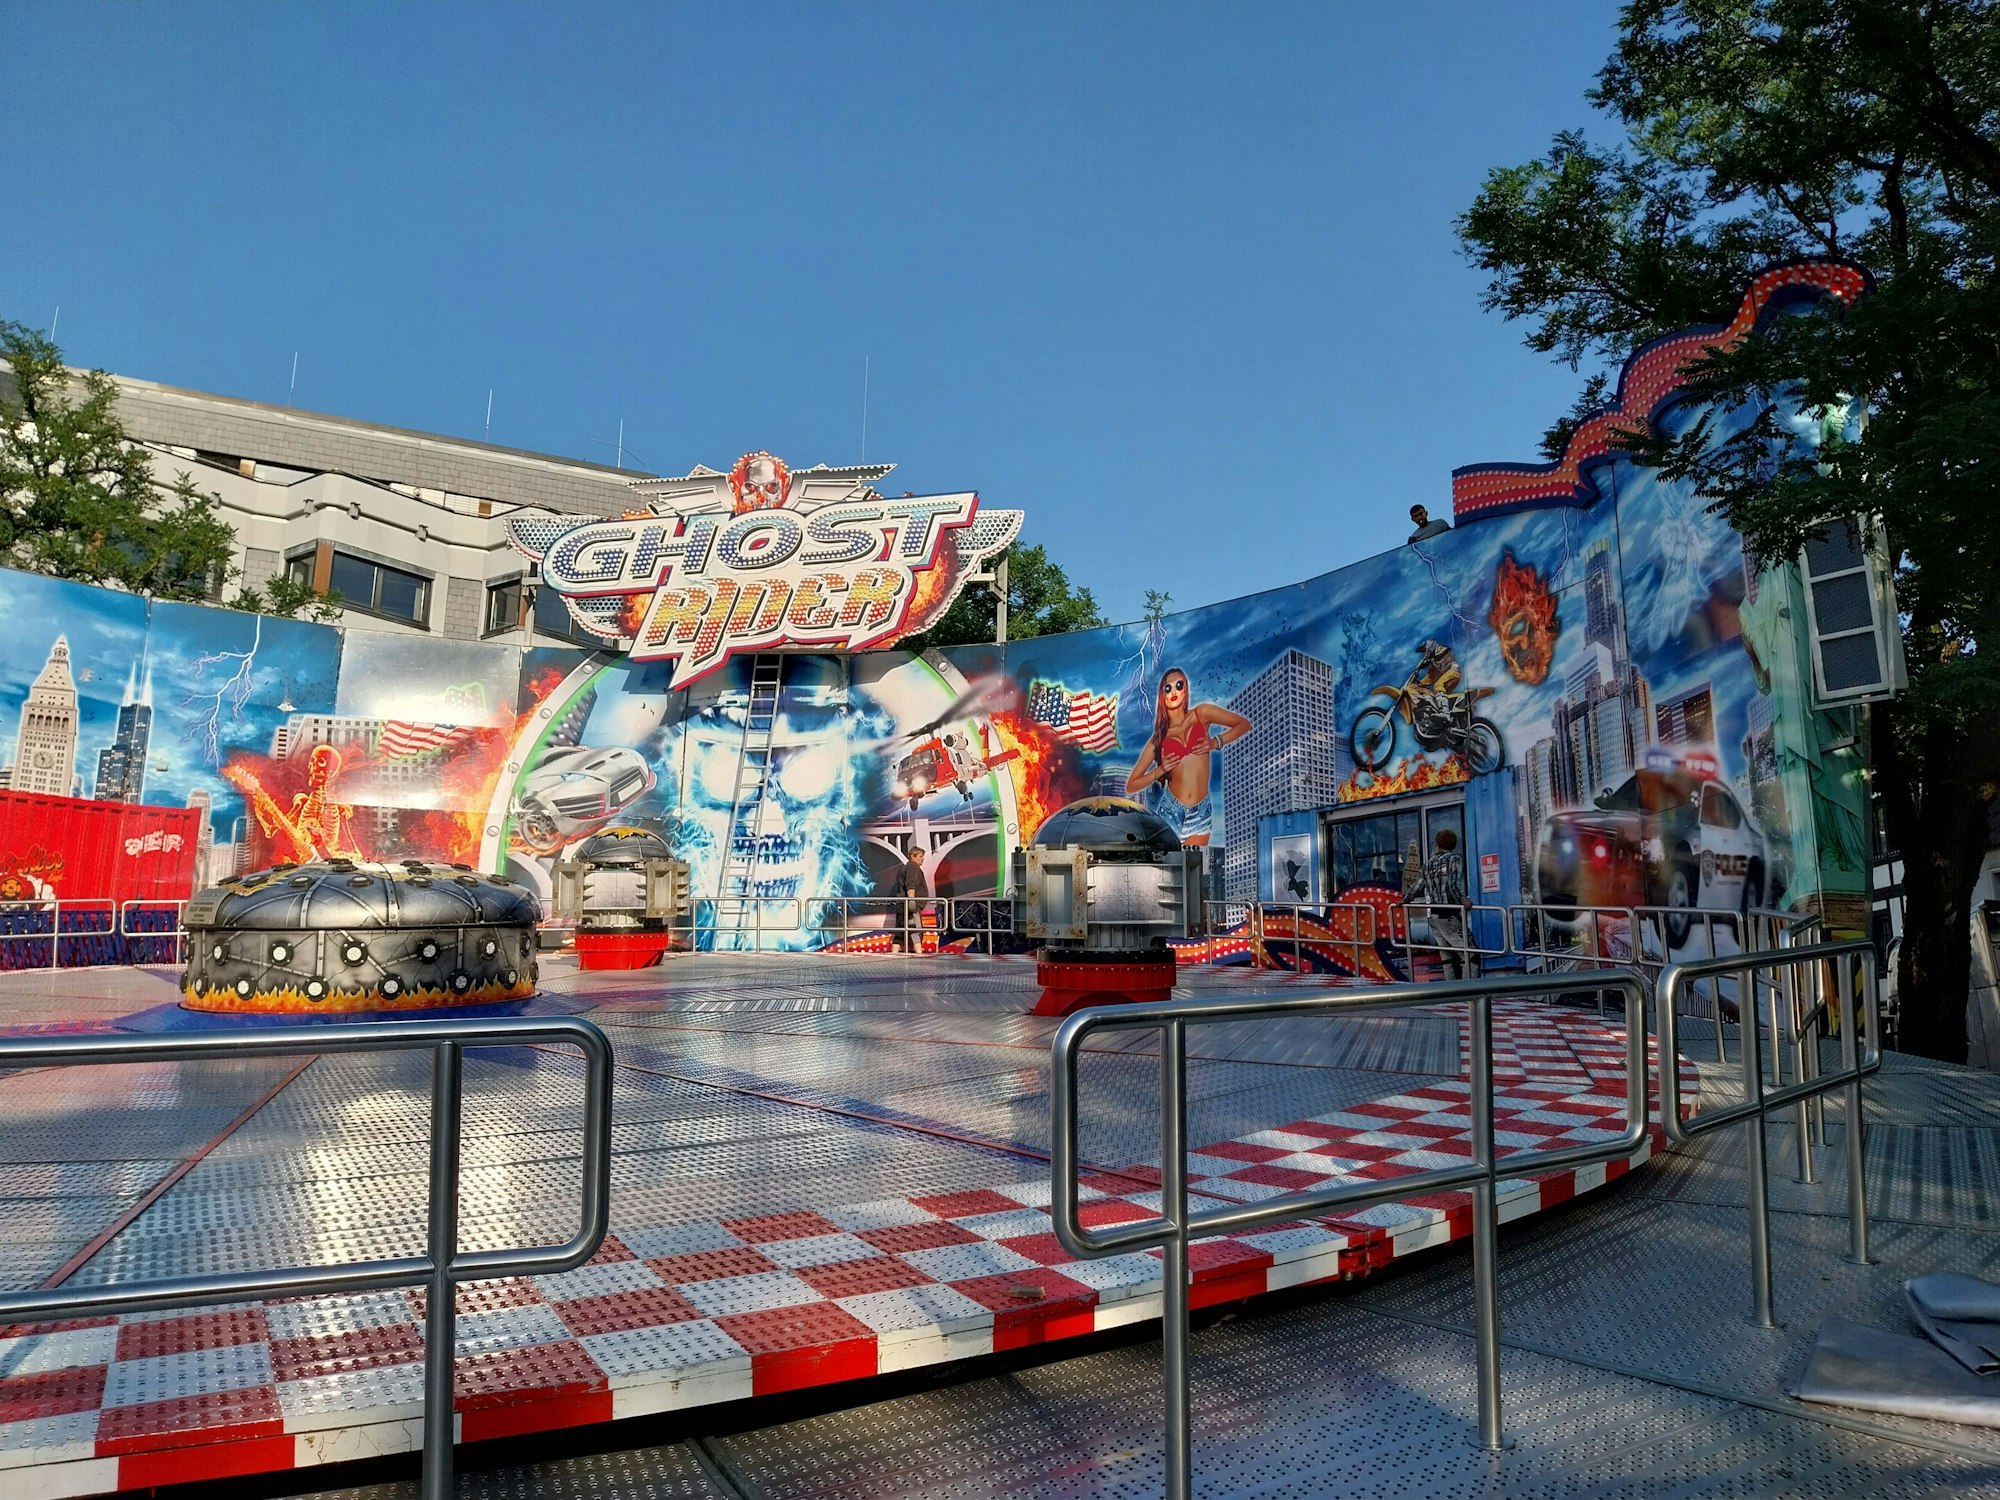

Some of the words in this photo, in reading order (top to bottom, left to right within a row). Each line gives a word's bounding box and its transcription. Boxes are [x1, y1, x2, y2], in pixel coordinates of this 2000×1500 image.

[552, 499, 963, 583] GHOST
[643, 566, 909, 666] RIDER
[1481, 863, 1499, 872] PARKING
[1714, 853, 1748, 876] POLICE
